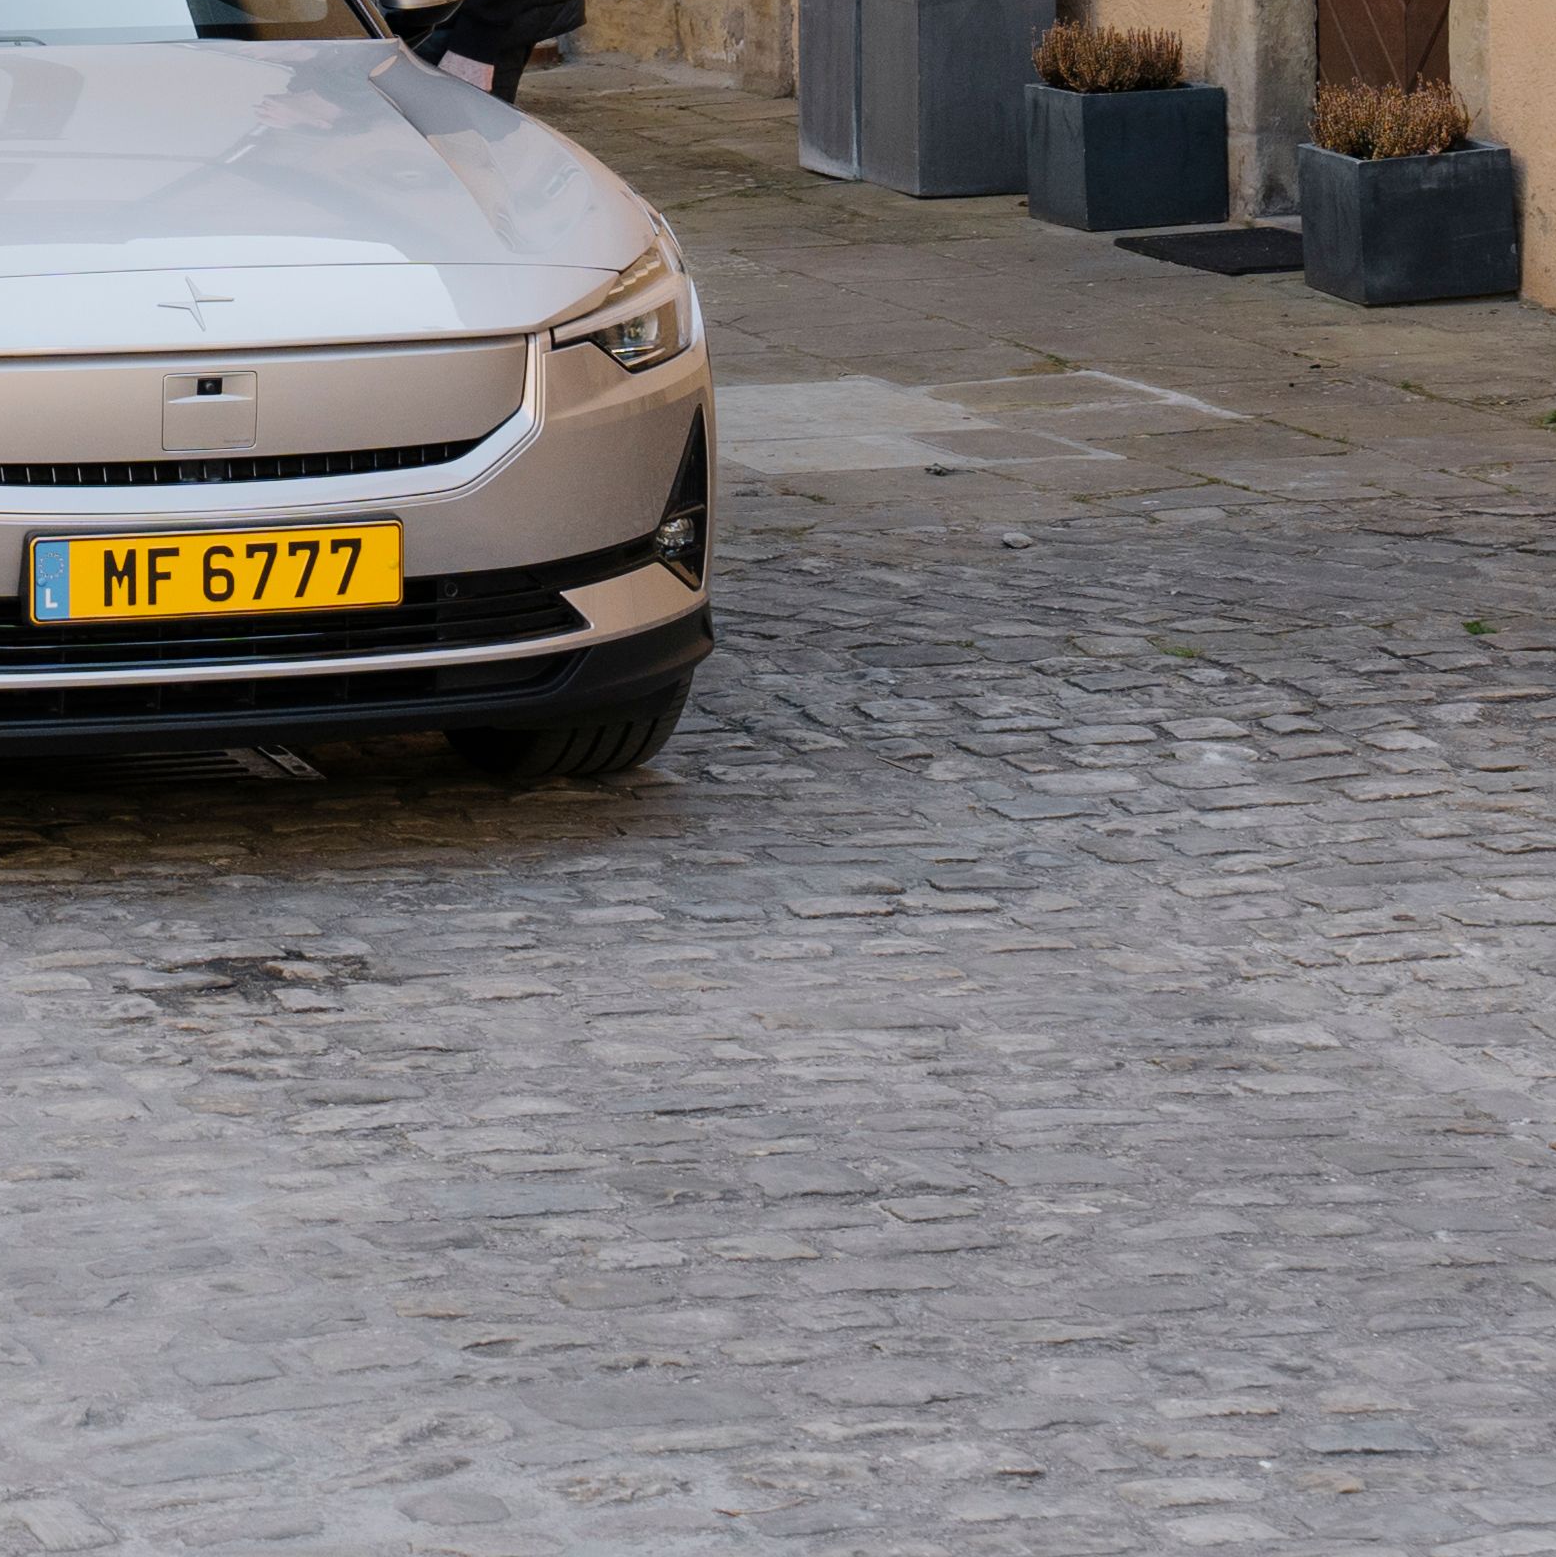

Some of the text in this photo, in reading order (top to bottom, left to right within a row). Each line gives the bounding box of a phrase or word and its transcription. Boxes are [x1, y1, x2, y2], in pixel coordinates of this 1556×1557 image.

[103, 538, 363, 607] MF 6777
[45, 588, 58, 609] L
